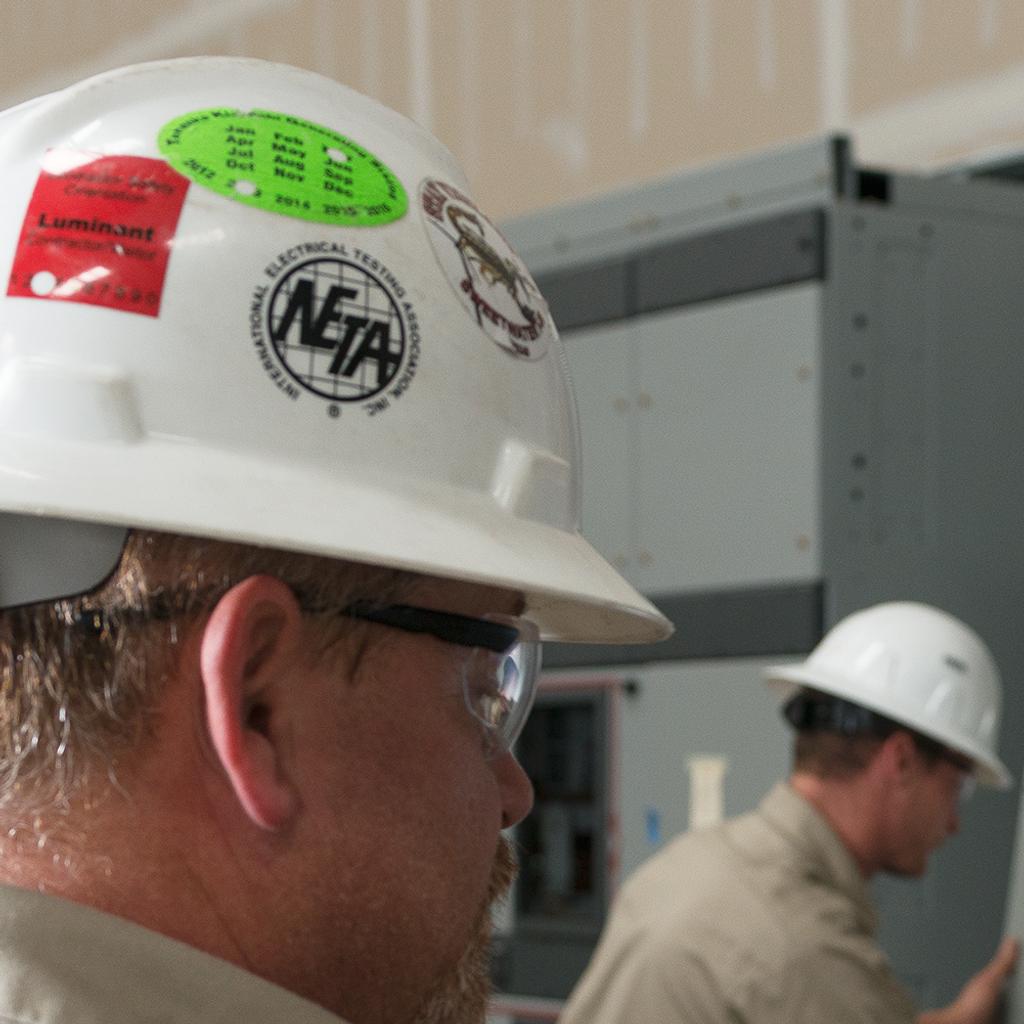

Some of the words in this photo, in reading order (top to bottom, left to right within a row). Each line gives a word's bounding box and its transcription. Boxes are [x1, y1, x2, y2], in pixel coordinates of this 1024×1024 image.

[226, 125, 255, 135] Jan
[274, 132, 303, 146] Feb
[226, 135, 254, 147] Apr
[272, 142, 306, 159] May
[226, 159, 256, 171] Oct
[274, 167, 304, 182] Nov
[324, 180, 354, 198] Dec
[227, 147, 254, 158] Jul
[274, 154, 305, 171] Aug
[324, 168, 353, 186] Sep
[38, 213, 155, 241] Luminant
[264, 241, 348, 278] ELECTRICAL
[353, 248, 406, 299] TESTING
[249, 284, 301, 400] INTERNATIONAL
[271, 278, 401, 387] NETA
